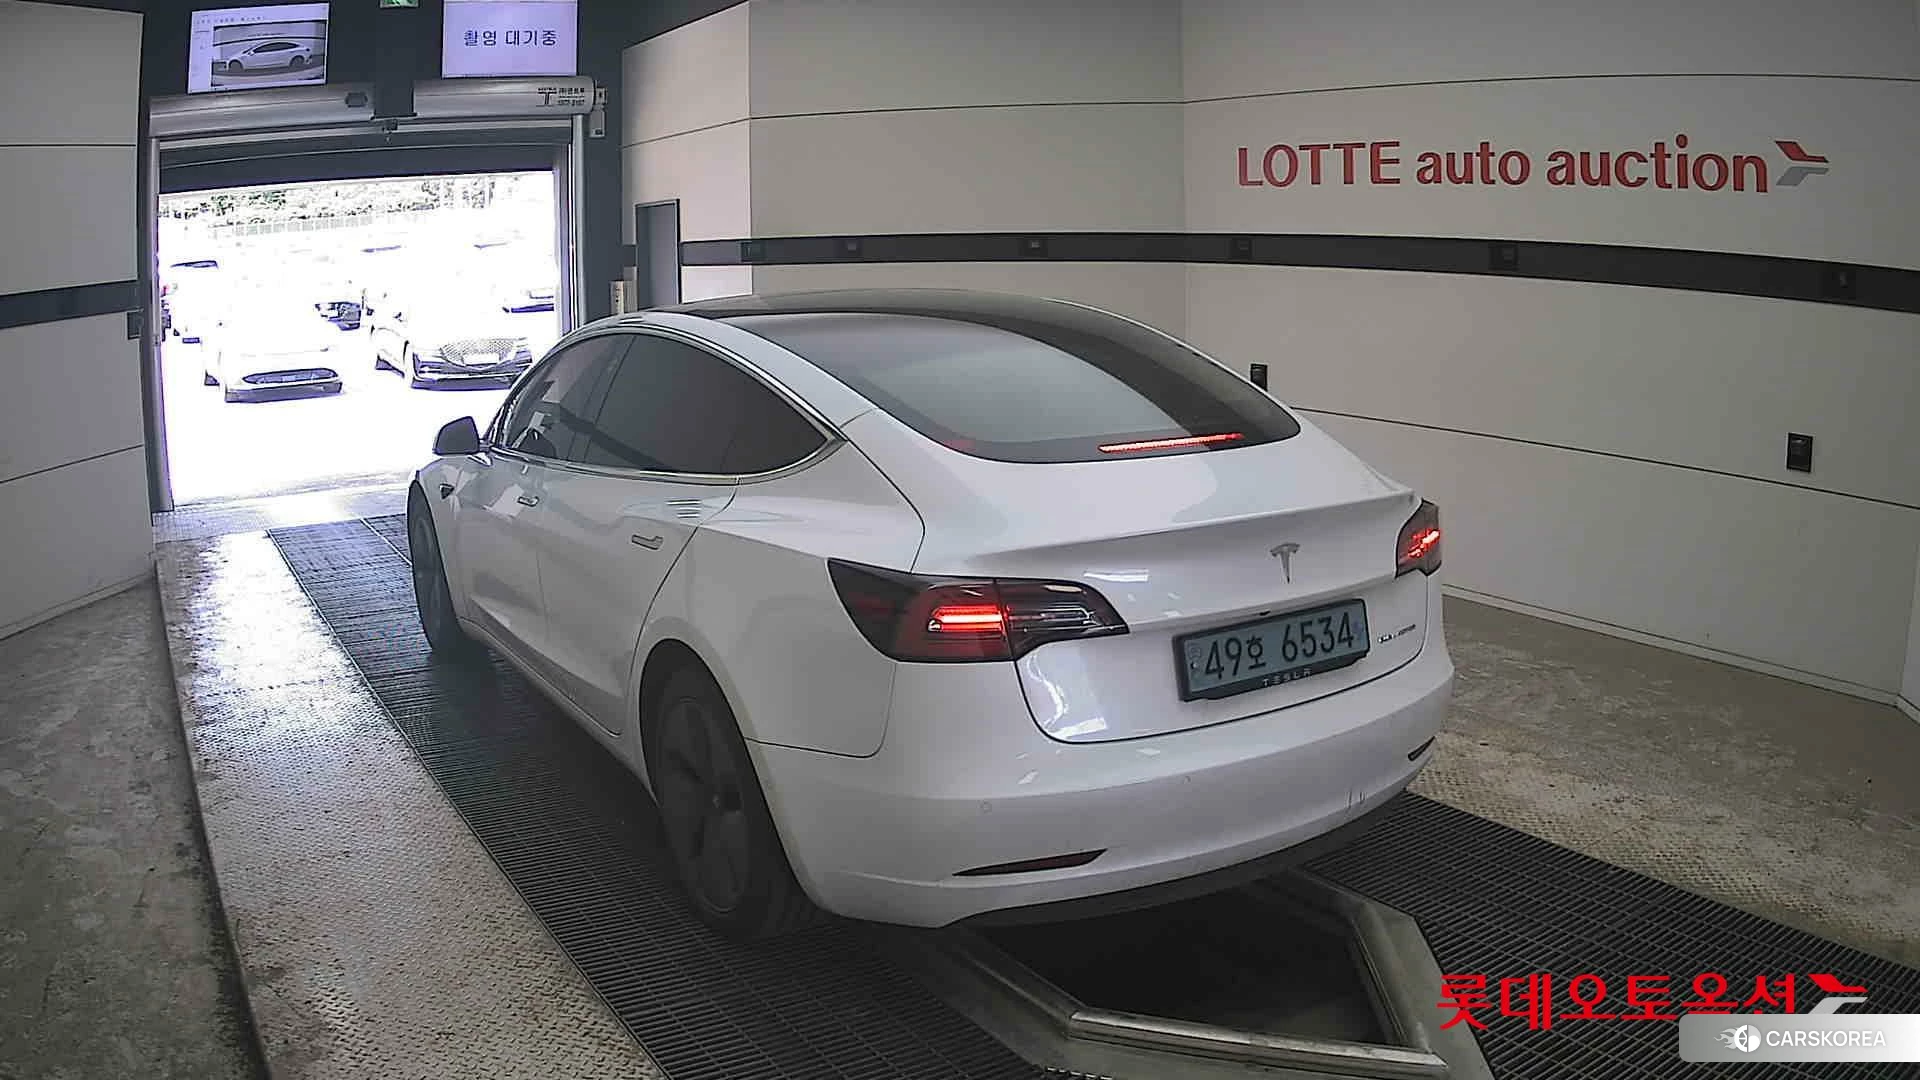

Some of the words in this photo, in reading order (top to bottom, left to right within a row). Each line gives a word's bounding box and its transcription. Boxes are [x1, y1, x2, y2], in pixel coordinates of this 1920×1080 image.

[464, 30, 497, 47] 촬영
[505, 30, 557, 46] 대기중
[1238, 141, 1400, 187] LOTTE
[1417, 143, 1531, 186] auto
[1547, 135, 1768, 193] auction
[1205, 636, 1266, 680] 49호
[1281, 611, 1354, 663] 6534
[1263, 668, 1312, 687] TESLA
